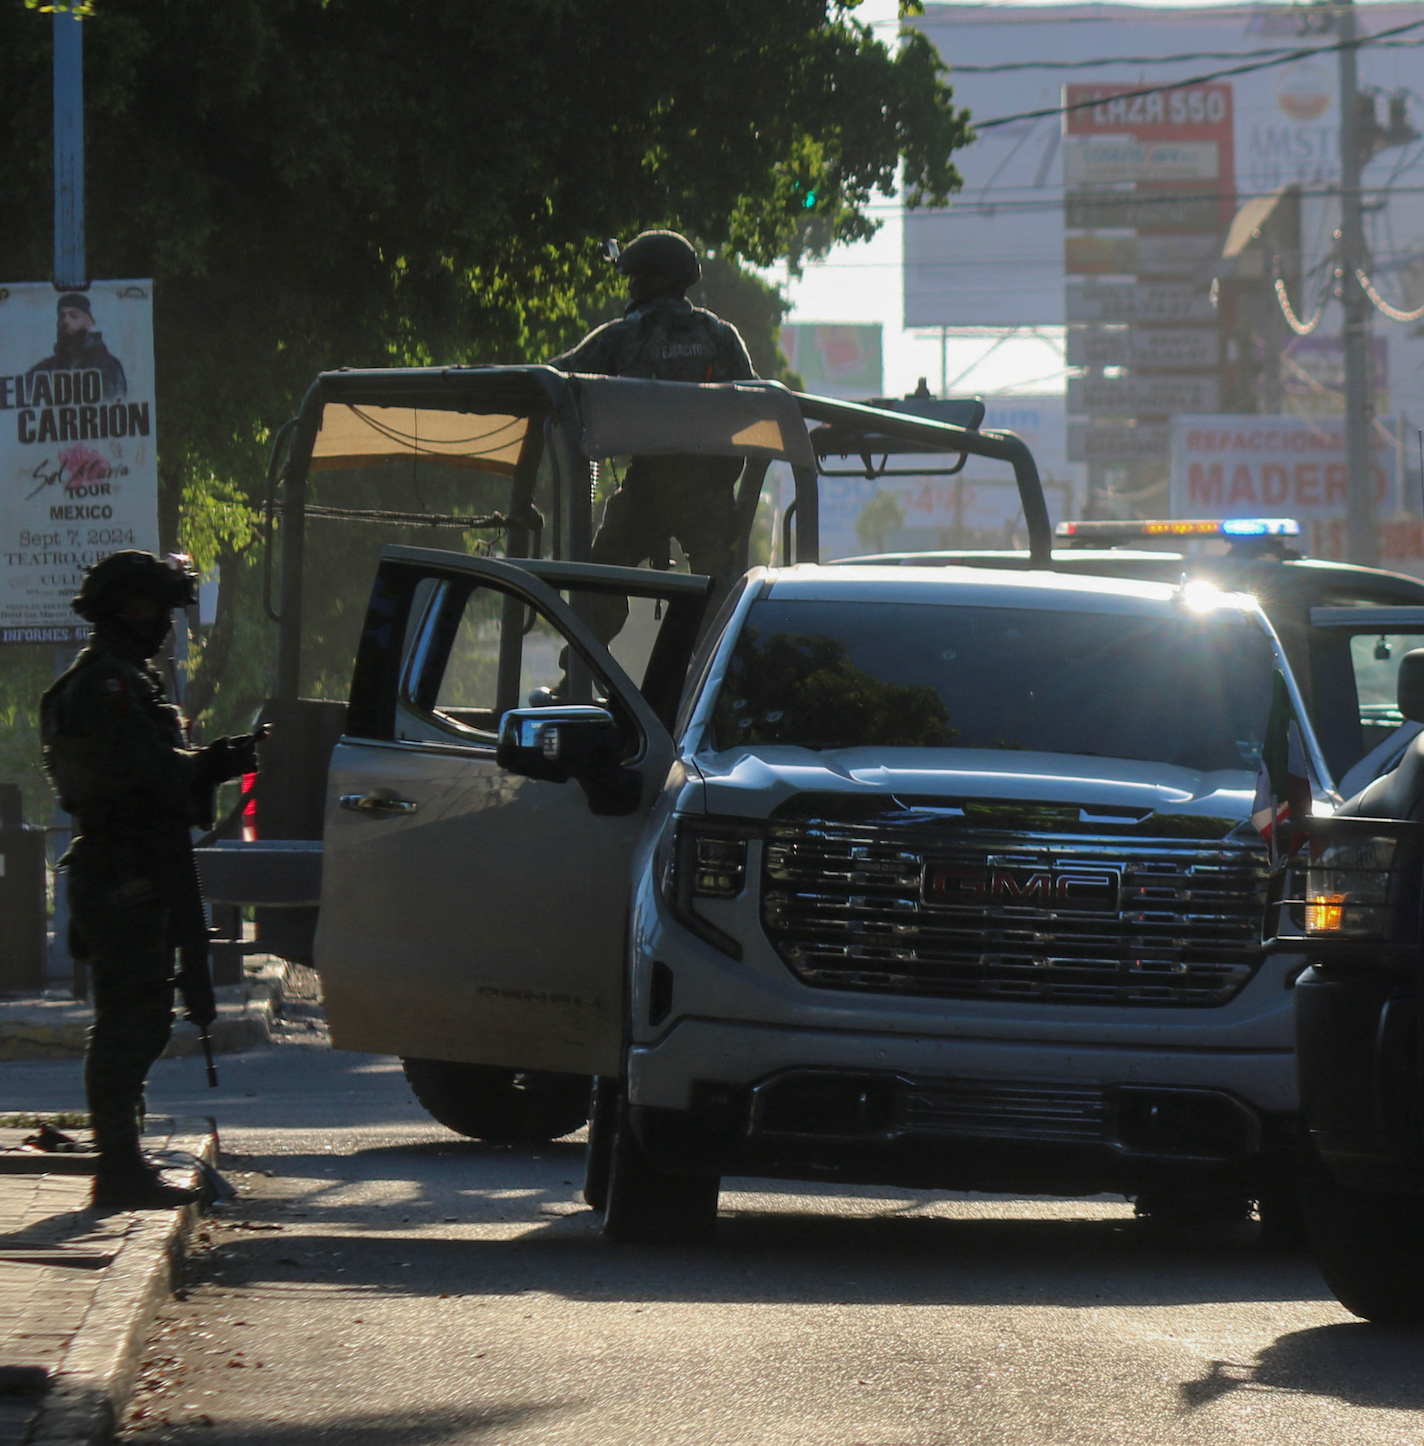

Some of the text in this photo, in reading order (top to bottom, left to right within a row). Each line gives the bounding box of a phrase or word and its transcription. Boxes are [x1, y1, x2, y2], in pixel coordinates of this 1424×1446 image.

[1168, 90, 1227, 125] 550
[0, 369, 102, 410] ELADIO
[18, 397, 151, 444] CARRIÓN
[65, 482, 112, 500] TOUR
[50, 504, 114, 521] MEXICO
[20, 526, 136, 549] Sept 7, 2024
[4, 551, 78, 566] TEATRO
[934, 870, 1111, 905] GMC
